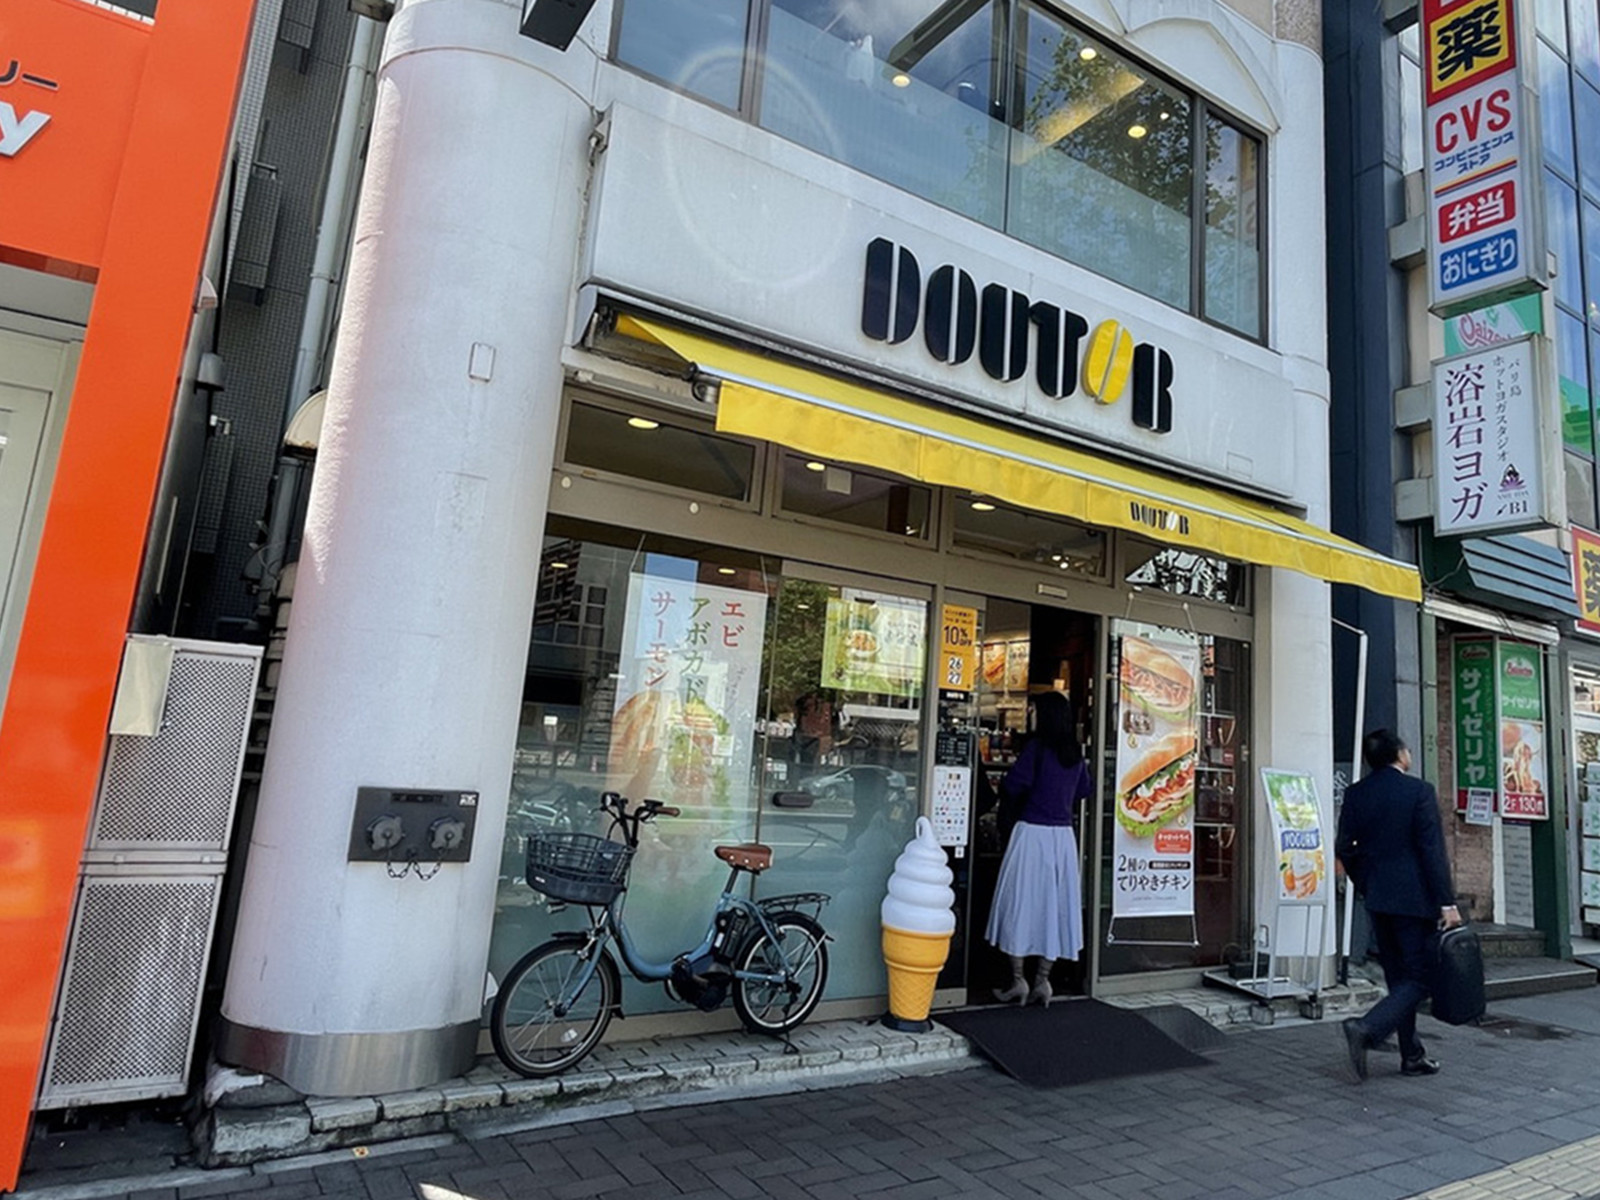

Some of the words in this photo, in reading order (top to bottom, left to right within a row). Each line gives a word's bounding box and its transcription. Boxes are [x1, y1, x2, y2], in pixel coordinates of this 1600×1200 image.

[1437, 1, 1502, 82] 薬
[1435, 89, 1511, 154] CVS
[1435, 131, 1515, 172] コンビニエンス
[1458, 153, 1490, 174] ストア
[1449, 189, 1505, 236] 弁当
[1442, 237, 1516, 284] おにぎり
[861, 237, 1174, 434] DOUTOR
[1445, 363, 1488, 523] 溶岩ヨガ
[645, 591, 677, 687] サーモン
[680, 597, 712, 704] アボカド
[721, 602, 745, 647] エビ
[1461, 668, 1486, 784] サイゼリヤ
[1117, 874, 1191, 892] てりやきチキン
